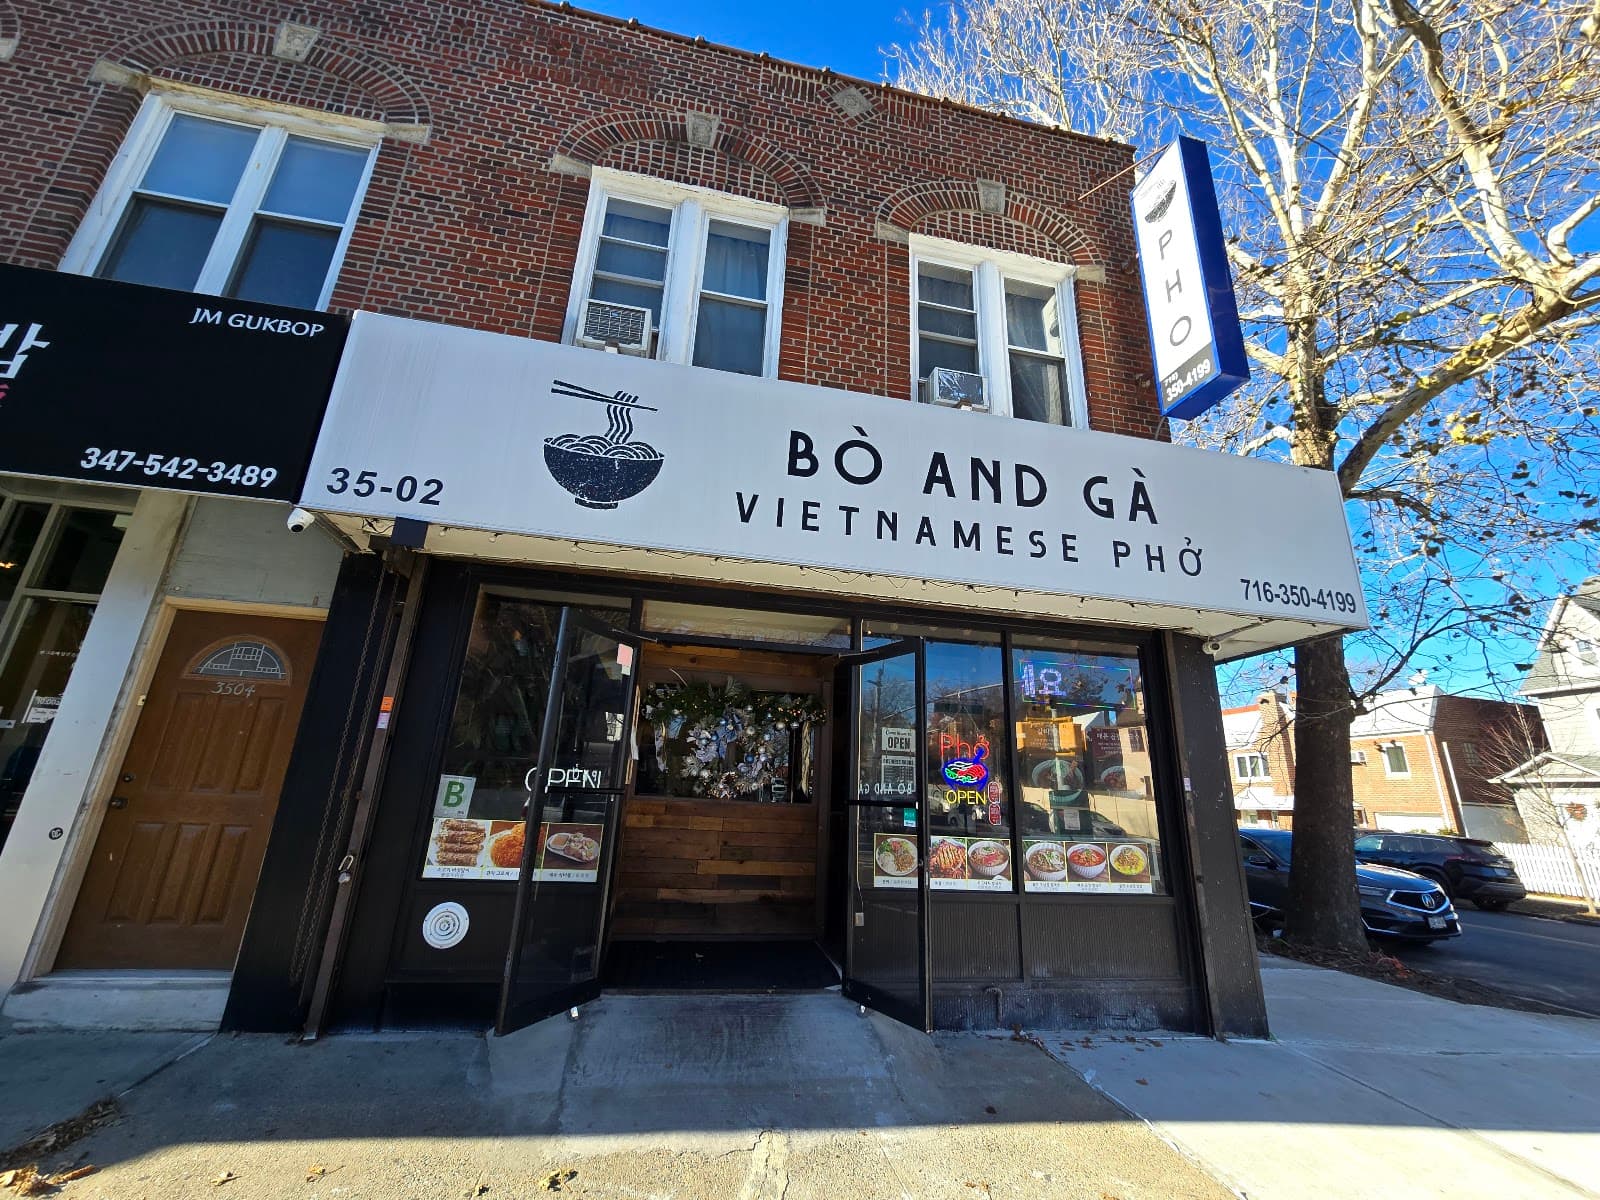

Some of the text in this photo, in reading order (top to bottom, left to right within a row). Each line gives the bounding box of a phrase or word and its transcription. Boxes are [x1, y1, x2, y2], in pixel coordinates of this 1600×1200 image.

[188, 307, 325, 338] JM GUKBOP
[1166, 358, 1210, 402] 350-4199
[80, 447, 278, 488] 347-542-3489
[787, 425, 1158, 525] BÒ AND GÀ
[326, 467, 444, 506] 35-02
[735, 491, 1203, 578] VIETNAMESE PHỞ
[1240, 578, 1357, 613] 716-350-4199
[210, 681, 256, 698] 3504
[887, 736, 912, 750] OPEN
[443, 780, 465, 808] B
[946, 789, 987, 805] OPEN
